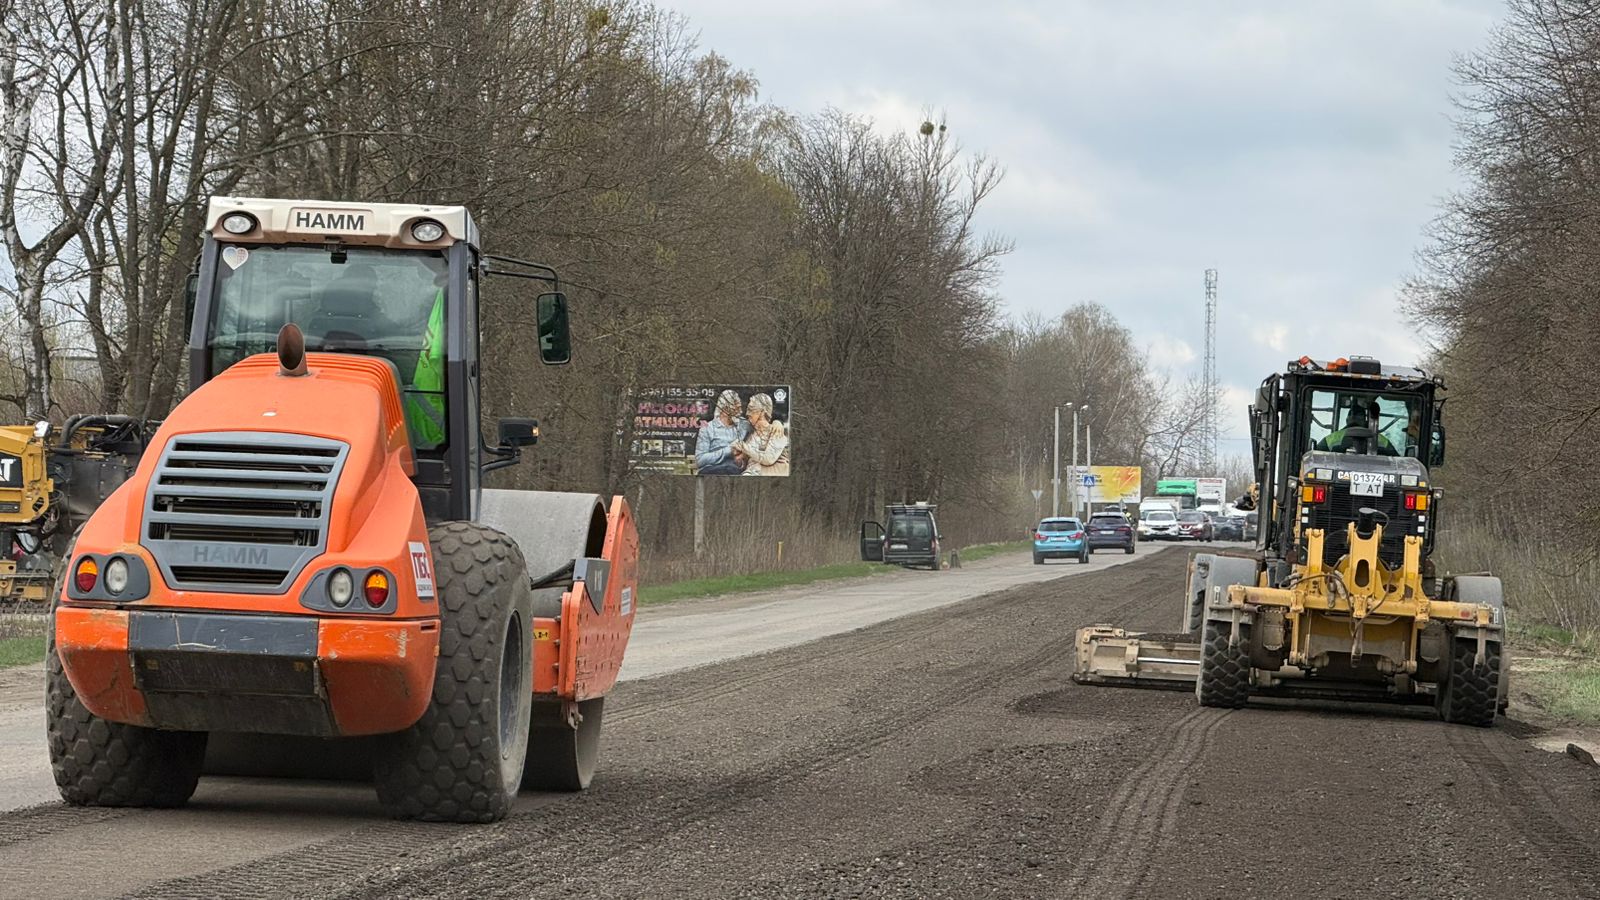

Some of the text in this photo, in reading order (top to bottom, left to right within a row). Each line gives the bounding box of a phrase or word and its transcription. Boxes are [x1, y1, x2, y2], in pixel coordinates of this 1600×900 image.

[296, 211, 365, 231] HAMM
[1353, 473, 1382, 483] 01374
[1353, 482, 1381, 494] T AT
[193, 545, 269, 565] HAMM
